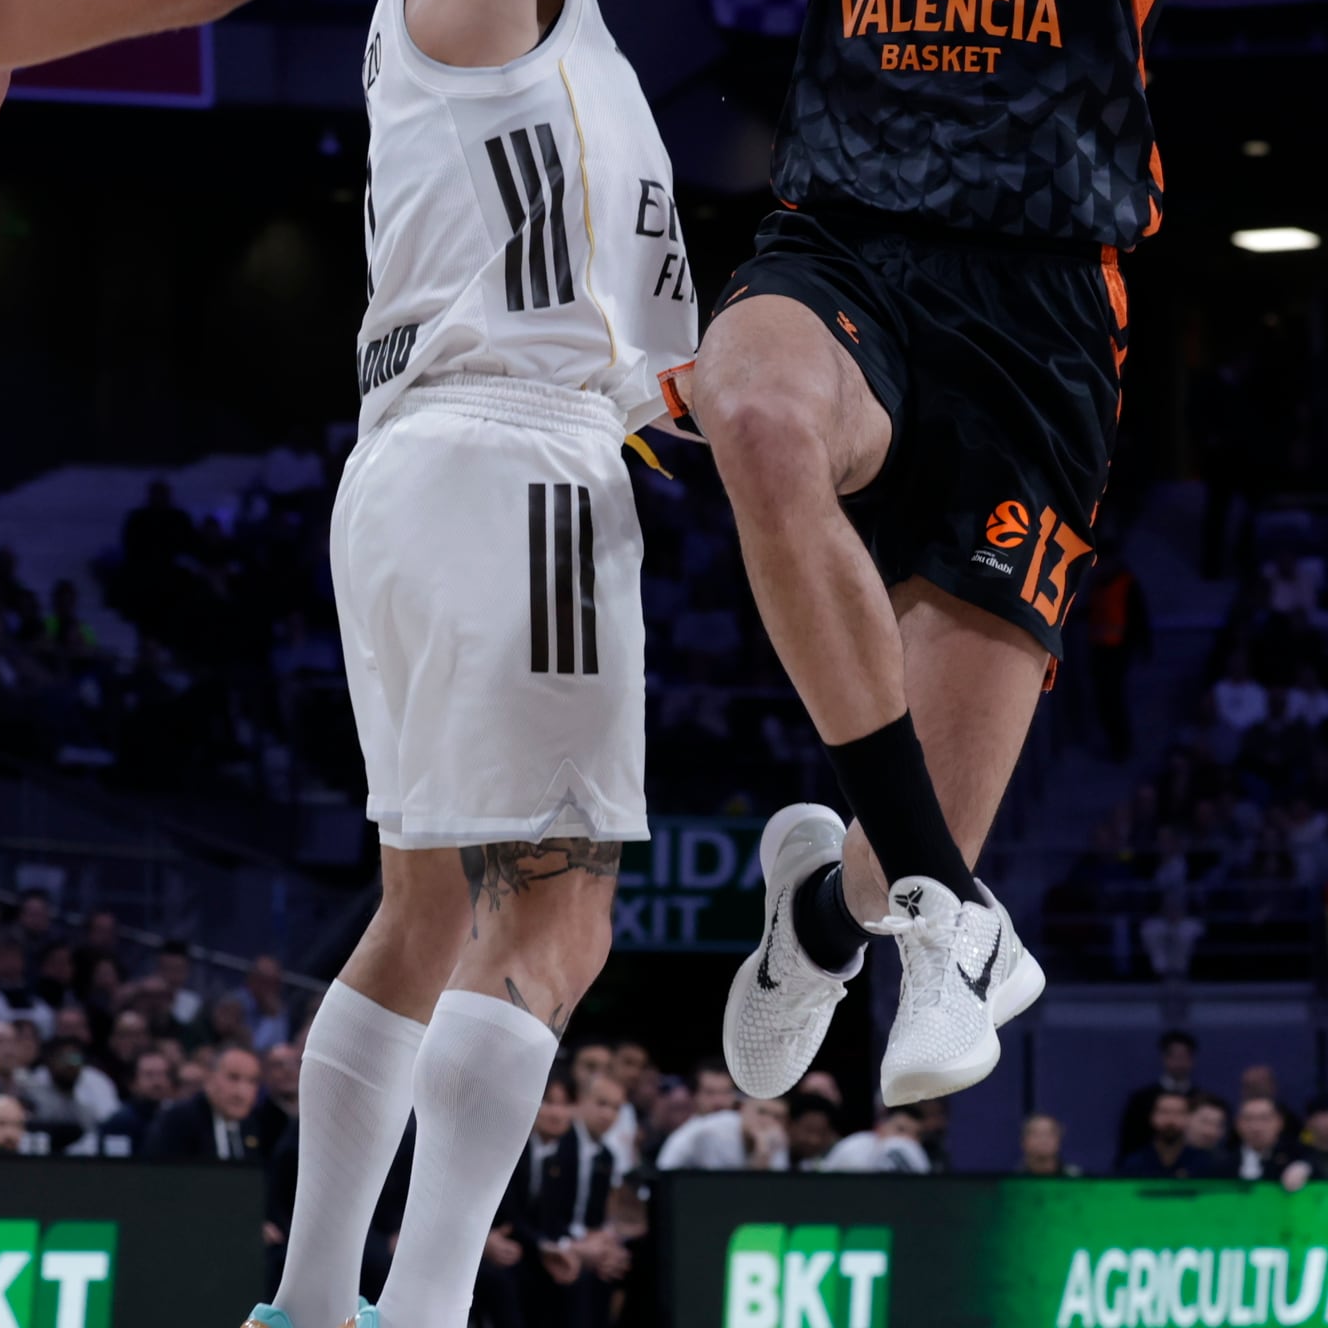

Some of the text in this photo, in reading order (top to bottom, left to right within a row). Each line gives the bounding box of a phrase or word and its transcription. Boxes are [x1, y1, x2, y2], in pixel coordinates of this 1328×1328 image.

[880, 43, 1002, 74] BASKET
[1019, 504, 1095, 628] 13
[727, 1250, 888, 1328] BKT
